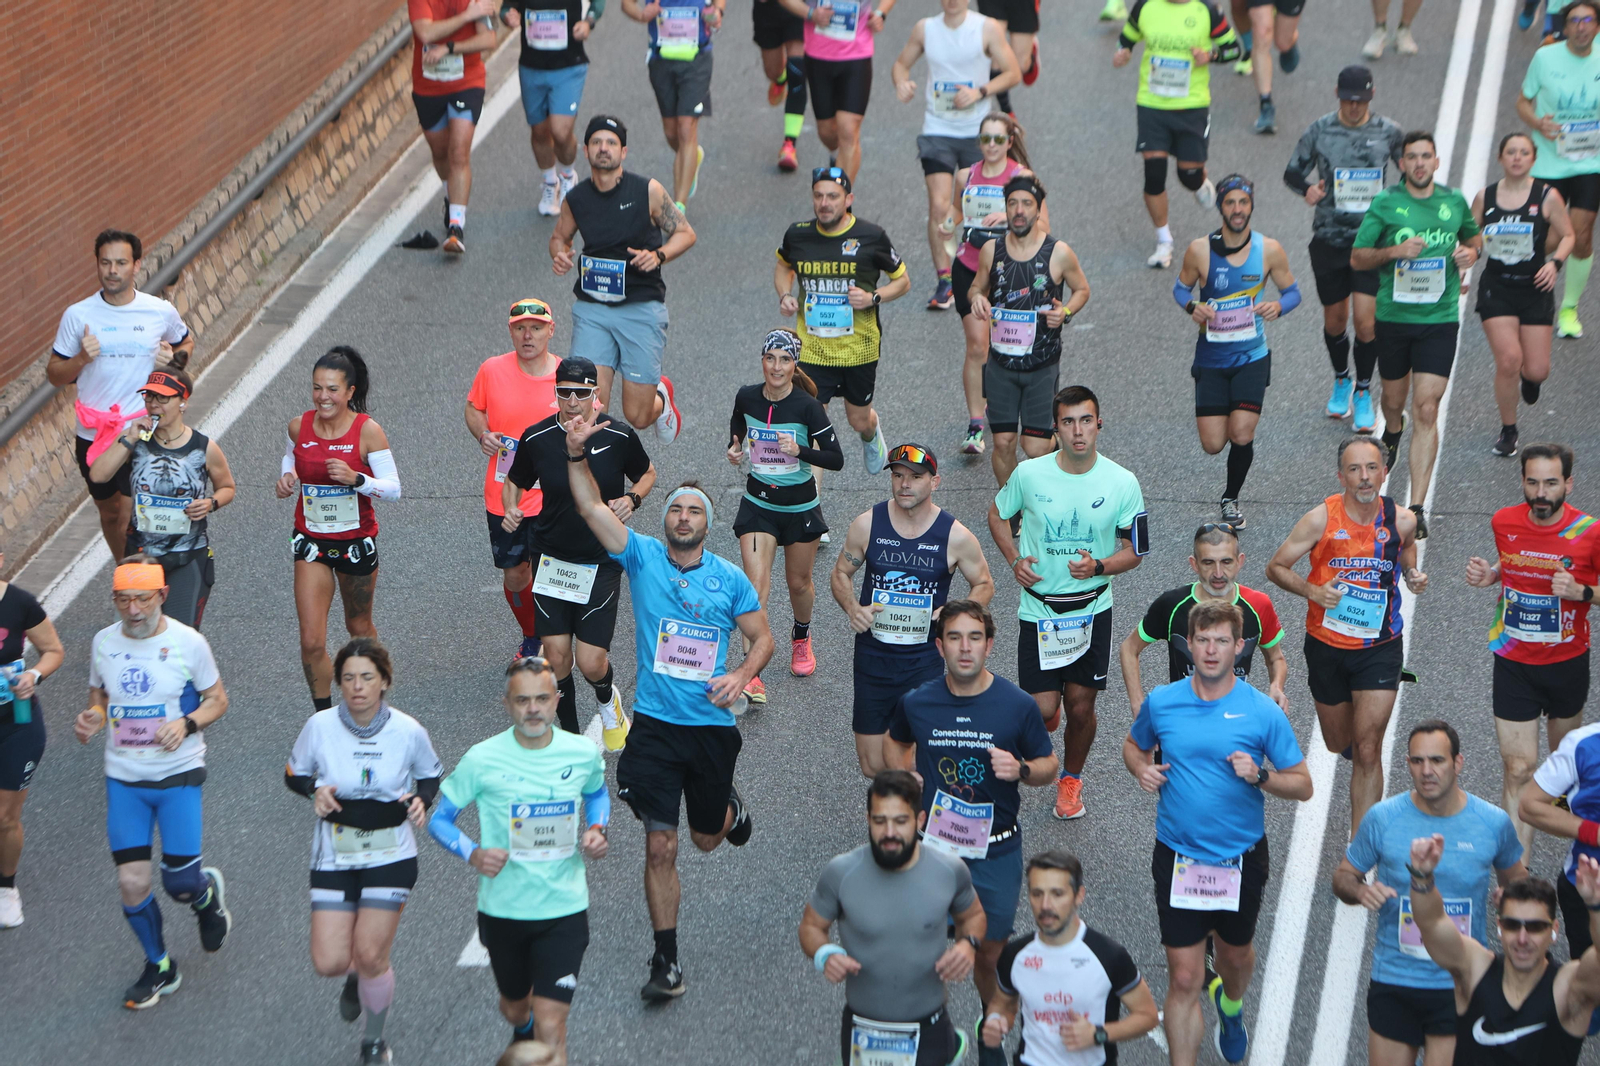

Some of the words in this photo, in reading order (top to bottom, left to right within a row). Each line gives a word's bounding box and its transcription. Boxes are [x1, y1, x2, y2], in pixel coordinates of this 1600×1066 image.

[1352, 170, 1380, 179] ZURICH
[595, 260, 619, 271] ZURICH
[1412, 260, 1439, 270] ZURICH
[819, 296, 845, 305] ZURICH
[1220, 299, 1246, 310] ZURICH
[1004, 312, 1030, 322] ZURICH
[1003, 327, 1019, 335] 7617
[1000, 337, 1022, 345] ALBERTO
[319, 487, 349, 496] ZURICH
[155, 498, 188, 507] ZURICH
[320, 504, 338, 512] 9571
[1328, 557, 1393, 572] ATLETISMO
[556, 568, 577, 579] 10423
[564, 581, 580, 590] LADY
[1351, 589, 1380, 601] ZURICH
[892, 597, 924, 606] ZURICH
[1520, 595, 1552, 606] ZURICH
[1346, 605, 1365, 616] 6324
[889, 613, 911, 623] 10421
[1337, 613, 1369, 628] CAYETANO
[1519, 612, 1541, 621] 11327
[874, 622, 900, 633] CRISTOF
[911, 625, 926, 633] MAT
[1057, 619, 1088, 629] ZURICH
[681, 626, 713, 640] ZURICH
[1059, 636, 1076, 646] 9291
[677, 645, 697, 657] 8048
[668, 655, 703, 668] DEVANNEY
[126, 707, 159, 717] ZURICH
[932, 729, 977, 738] Conectados
[978, 732, 993, 741] por
[928, 738, 957, 747] nuestro
[957, 739, 995, 750] propósito
[534, 806, 568, 816] ZURICH
[954, 805, 986, 818] ZURICH
[938, 829, 977, 846] DAMASEVIC
[1044, 990, 1073, 1006] edp
